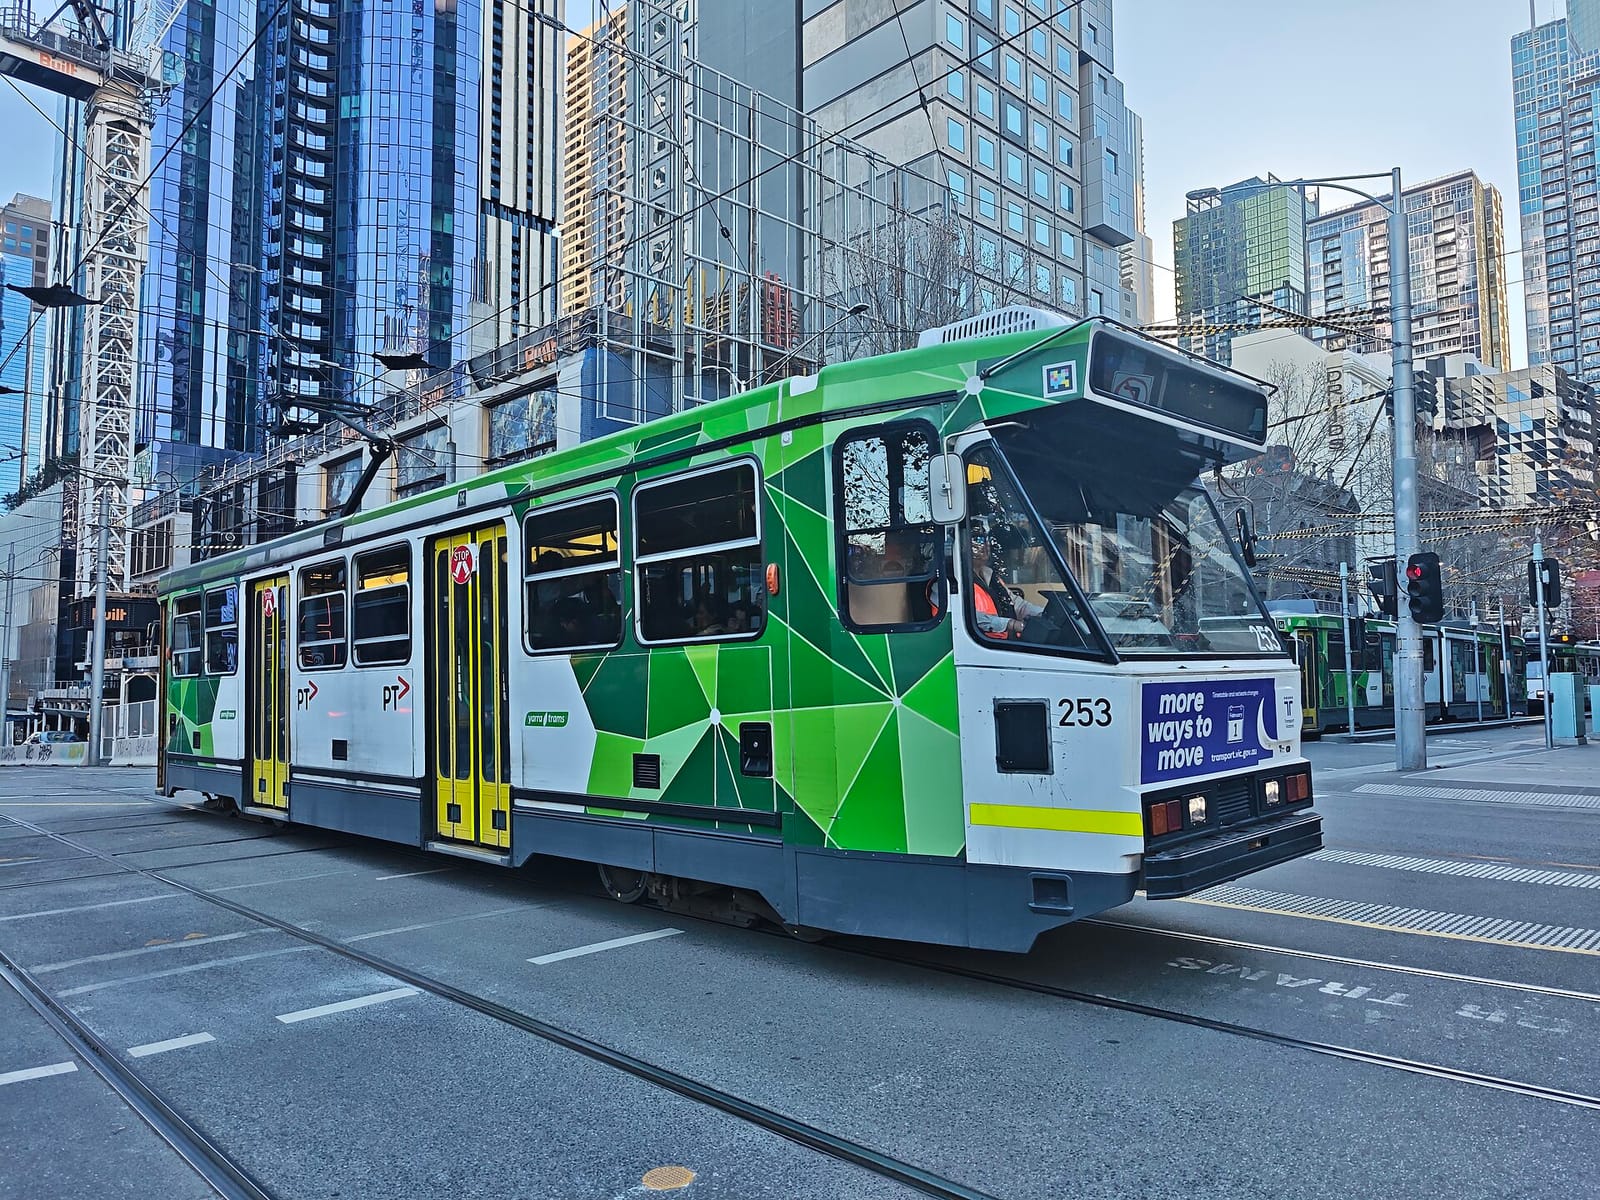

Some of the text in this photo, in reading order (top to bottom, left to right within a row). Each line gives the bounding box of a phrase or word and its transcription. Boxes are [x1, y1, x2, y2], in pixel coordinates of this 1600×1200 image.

[39, 52, 77, 75] Built
[453, 550, 470, 562] STOP
[92, 607, 127, 621] uilt
[1249, 625, 1282, 651] 253
[1058, 698, 1113, 727] 253
[1159, 692, 1204, 714] more
[527, 713, 565, 725] yarra trams
[1148, 714, 1212, 748] ways to
[1157, 745, 1204, 771] move
